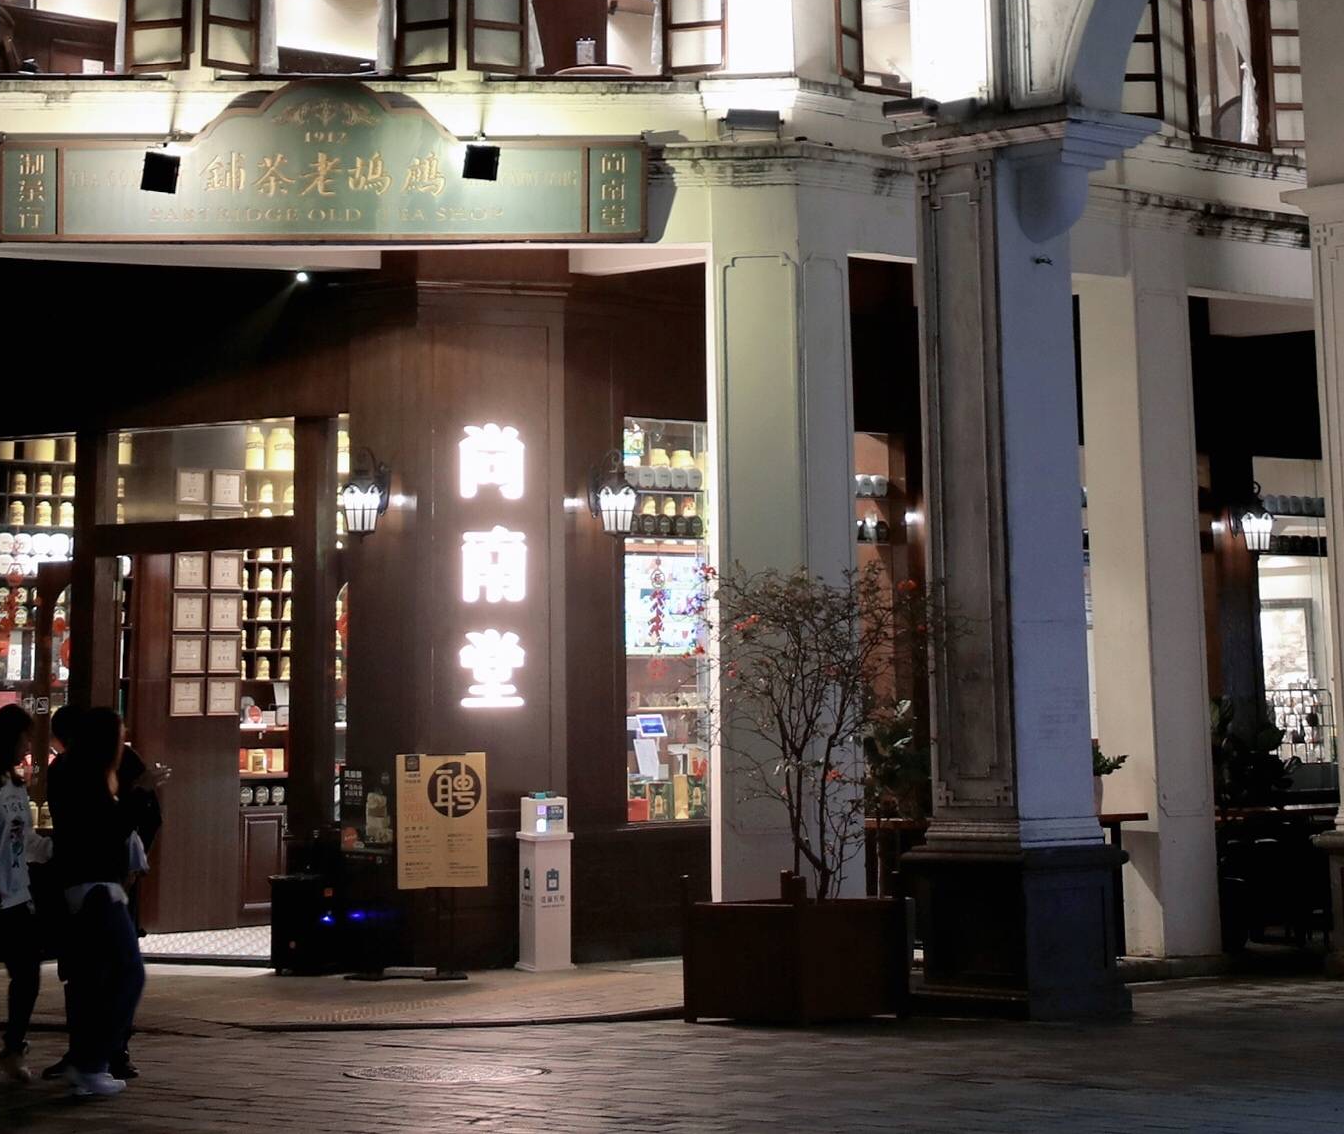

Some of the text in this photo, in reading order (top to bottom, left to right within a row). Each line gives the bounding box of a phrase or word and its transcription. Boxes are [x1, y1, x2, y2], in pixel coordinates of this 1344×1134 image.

[307, 208, 361, 222] OLD
[435, 207, 503, 221] SHOP
[432, 762, 477, 817] 聘
